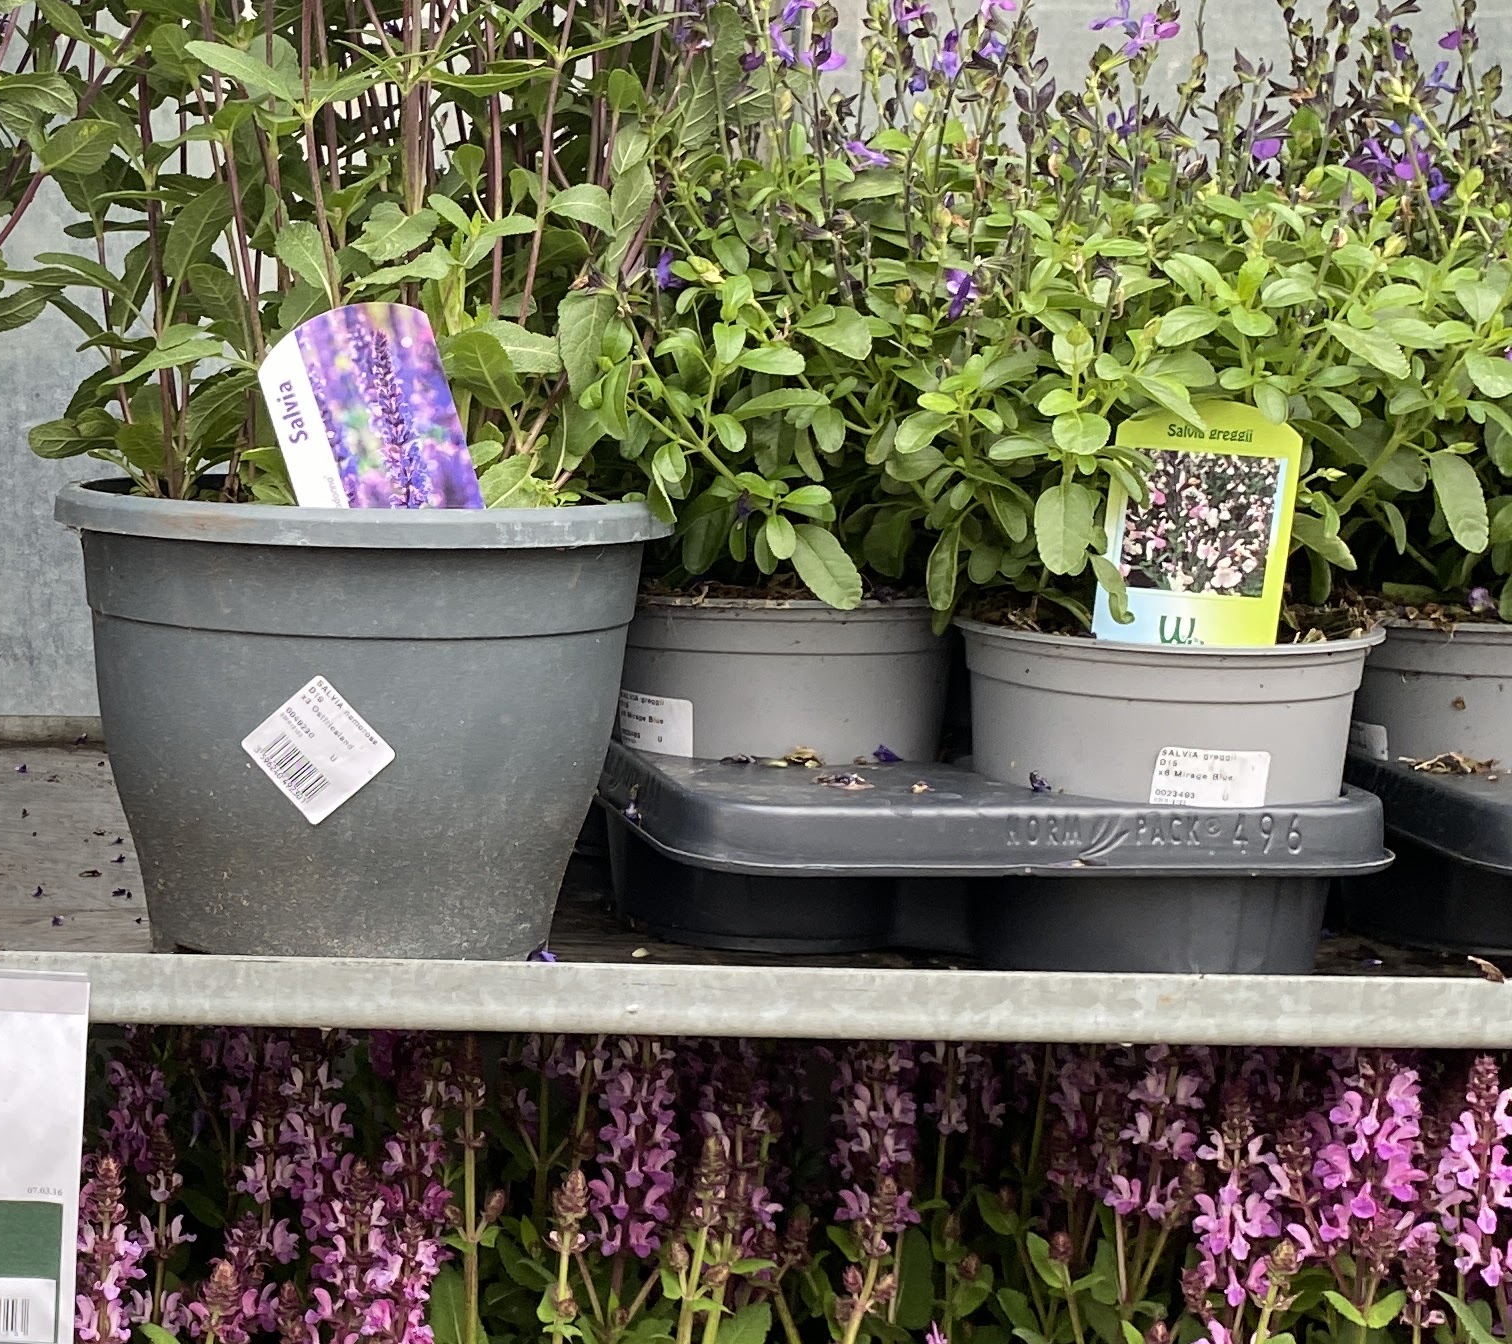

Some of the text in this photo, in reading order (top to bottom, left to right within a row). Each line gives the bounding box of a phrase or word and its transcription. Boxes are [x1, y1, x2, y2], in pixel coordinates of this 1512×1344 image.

[277, 380, 308, 444] Salvia
[1209, 428, 1254, 443] greggii
[316, 680, 343, 709] SALVIA
[1162, 749, 1198, 758] SALVIA
[1233, 814, 1302, 854] 496
[28, 1187, 63, 1196] 07.03.16
